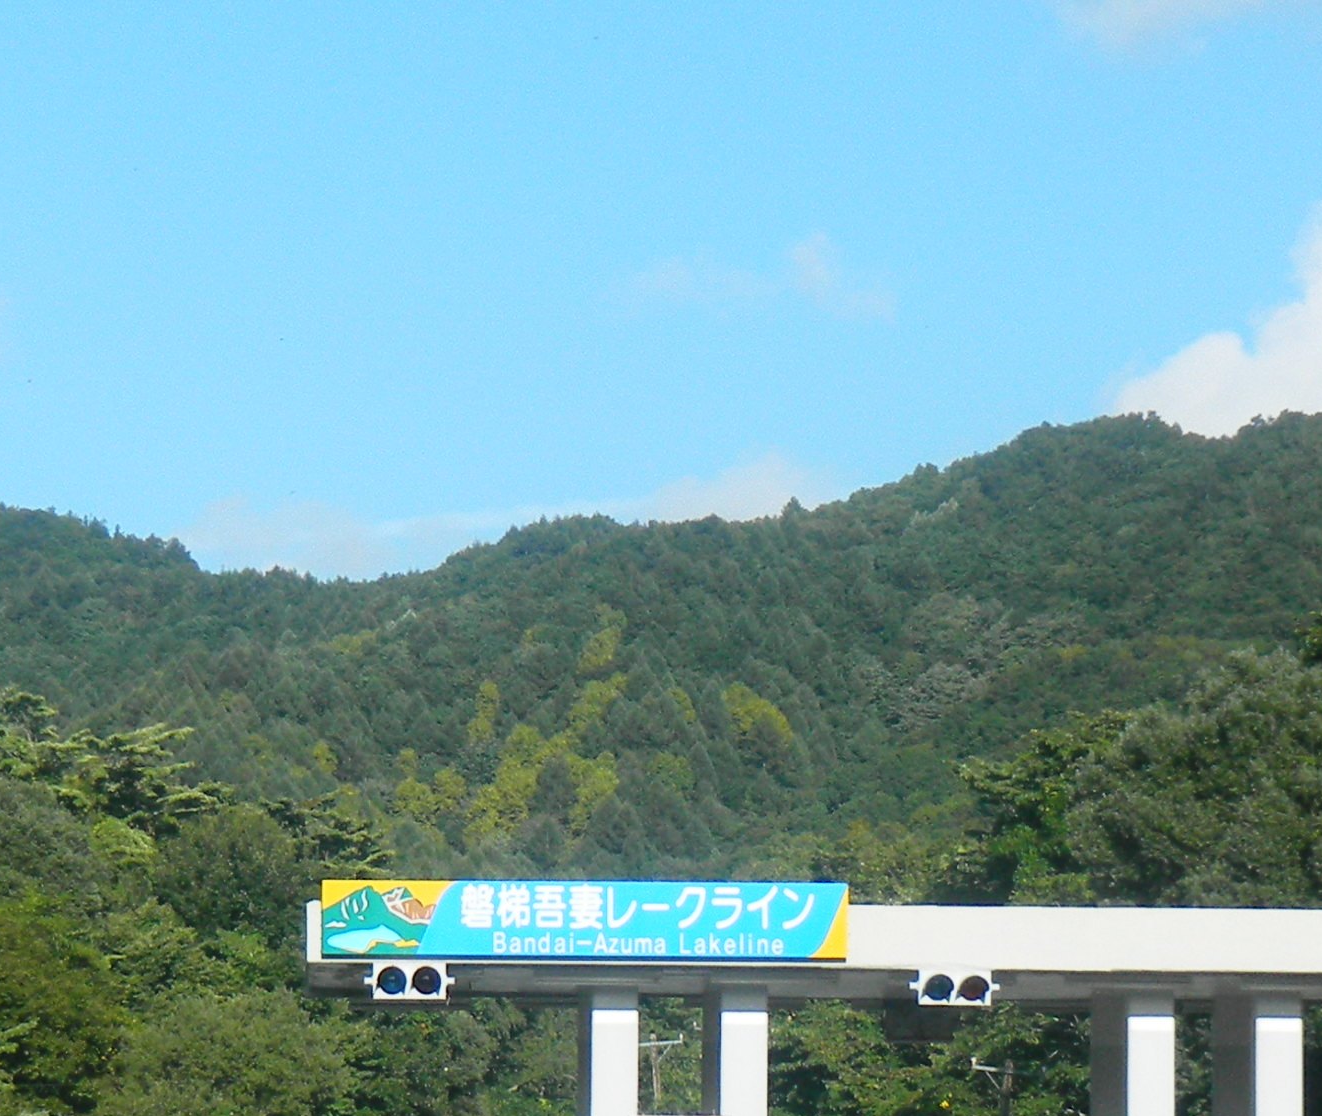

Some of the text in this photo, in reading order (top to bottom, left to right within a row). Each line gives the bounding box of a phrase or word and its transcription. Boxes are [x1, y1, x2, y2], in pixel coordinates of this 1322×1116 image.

[460, 883, 815, 930] 磐梯吾妻レークライン
[493, 931, 784, 955] Bandai-Azuma Lakeline
